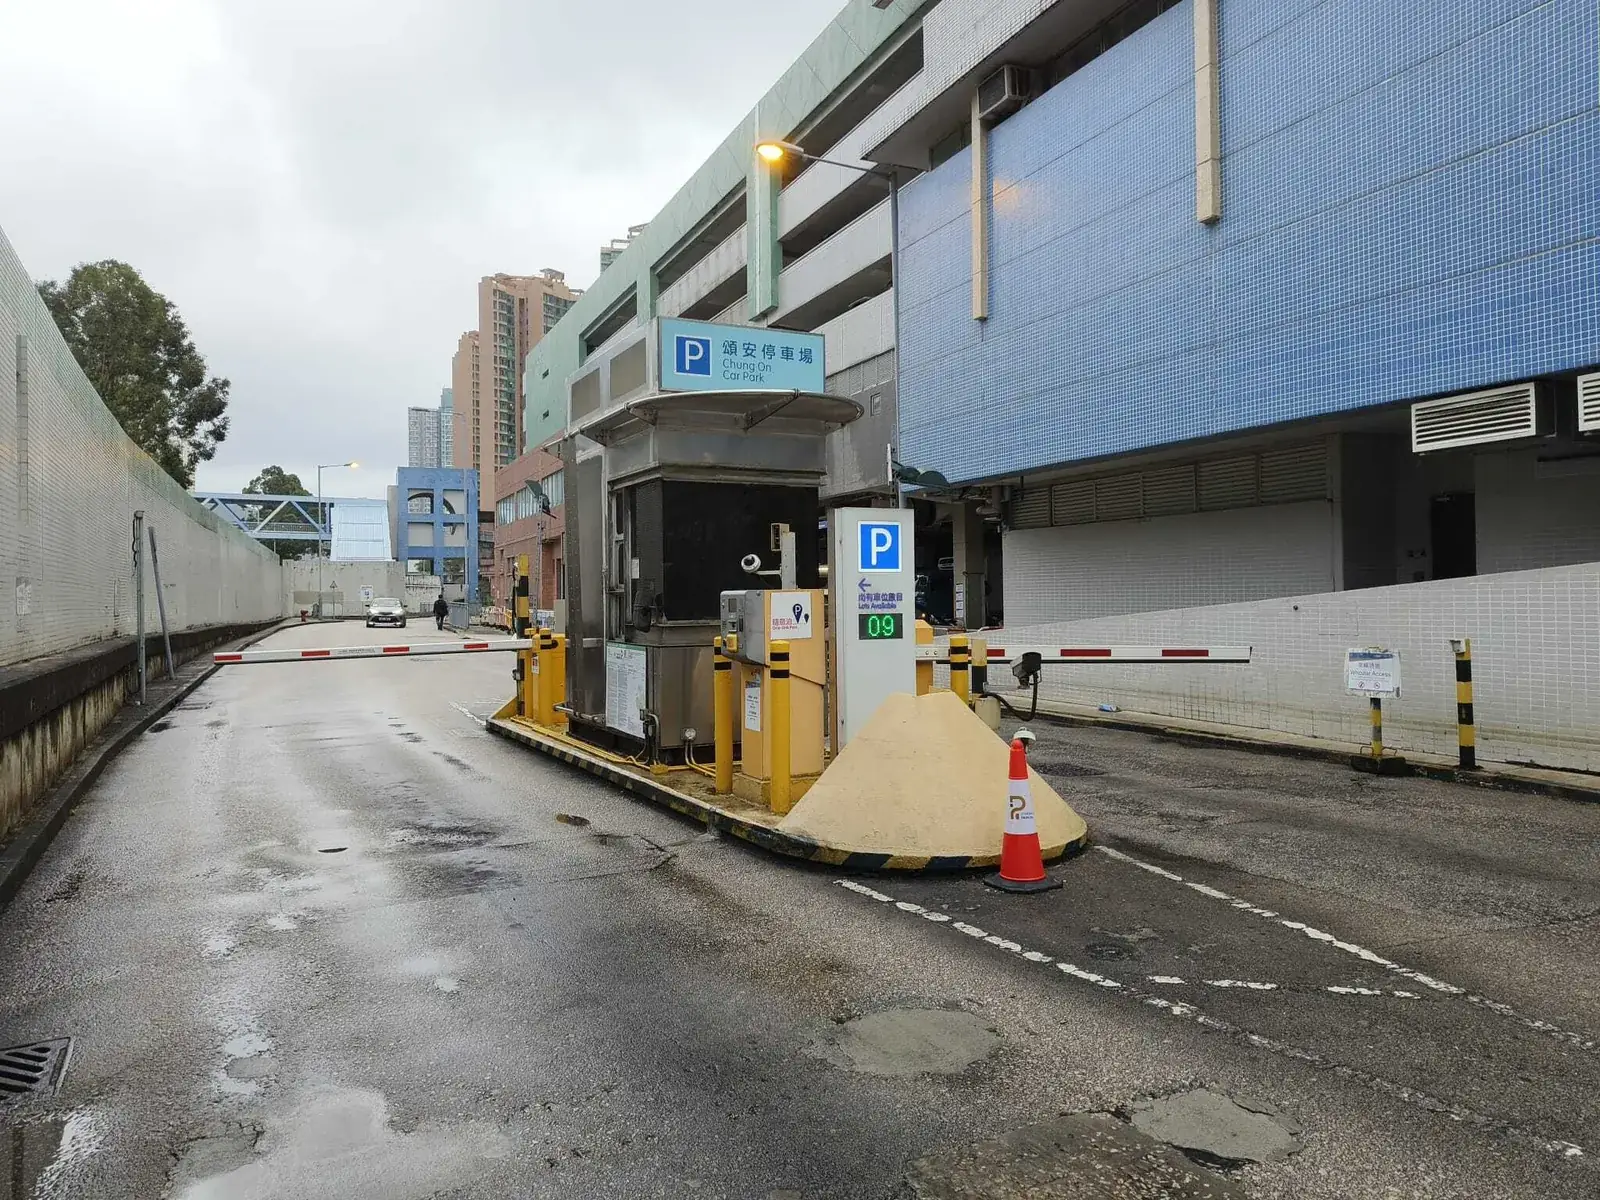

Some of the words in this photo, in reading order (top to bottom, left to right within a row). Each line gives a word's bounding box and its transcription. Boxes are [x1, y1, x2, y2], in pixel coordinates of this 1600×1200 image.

[685, 340, 704, 371] P
[722, 340, 813, 364] 頌安停車場
[722, 358, 756, 373] Chung
[757, 363, 772, 373] On
[722, 370, 740, 381] Car
[743, 372, 765, 383] Park
[871, 527, 893, 566] P
[858, 602, 870, 610] Lots
[870, 602, 897, 610] Available
[868, 615, 894, 637] 09
